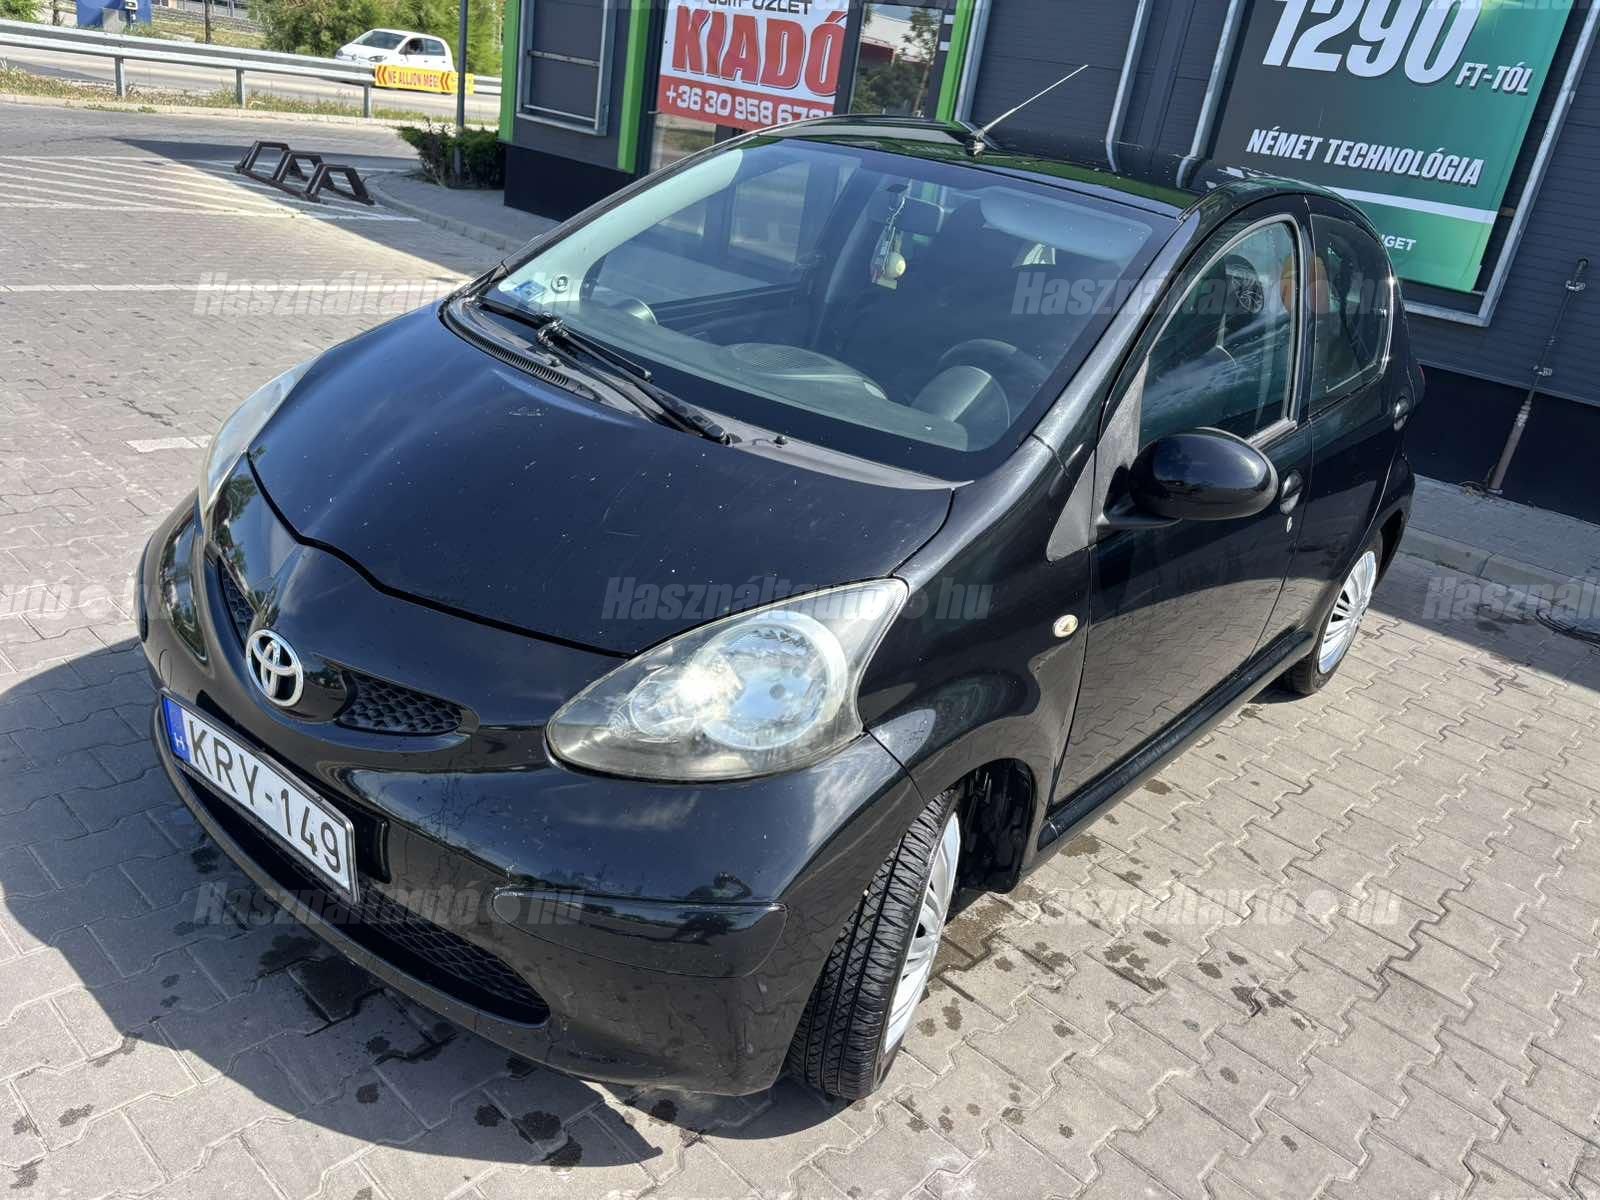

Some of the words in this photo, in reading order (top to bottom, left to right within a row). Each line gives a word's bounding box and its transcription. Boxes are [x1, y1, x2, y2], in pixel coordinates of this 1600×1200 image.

[672, 5, 848, 96] KIADÓ
[1262, 0, 1482, 84] 1290
[1455, 62, 1533, 94] FT-TÓL
[666, 84, 702, 111] +36
[704, 91, 732, 116] 30
[735, 96, 774, 125] 958
[1246, 126, 1323, 161] NÉMET
[1323, 138, 1485, 186] TECHNOLÓGIA
[189, 719, 341, 873] KRY-149
